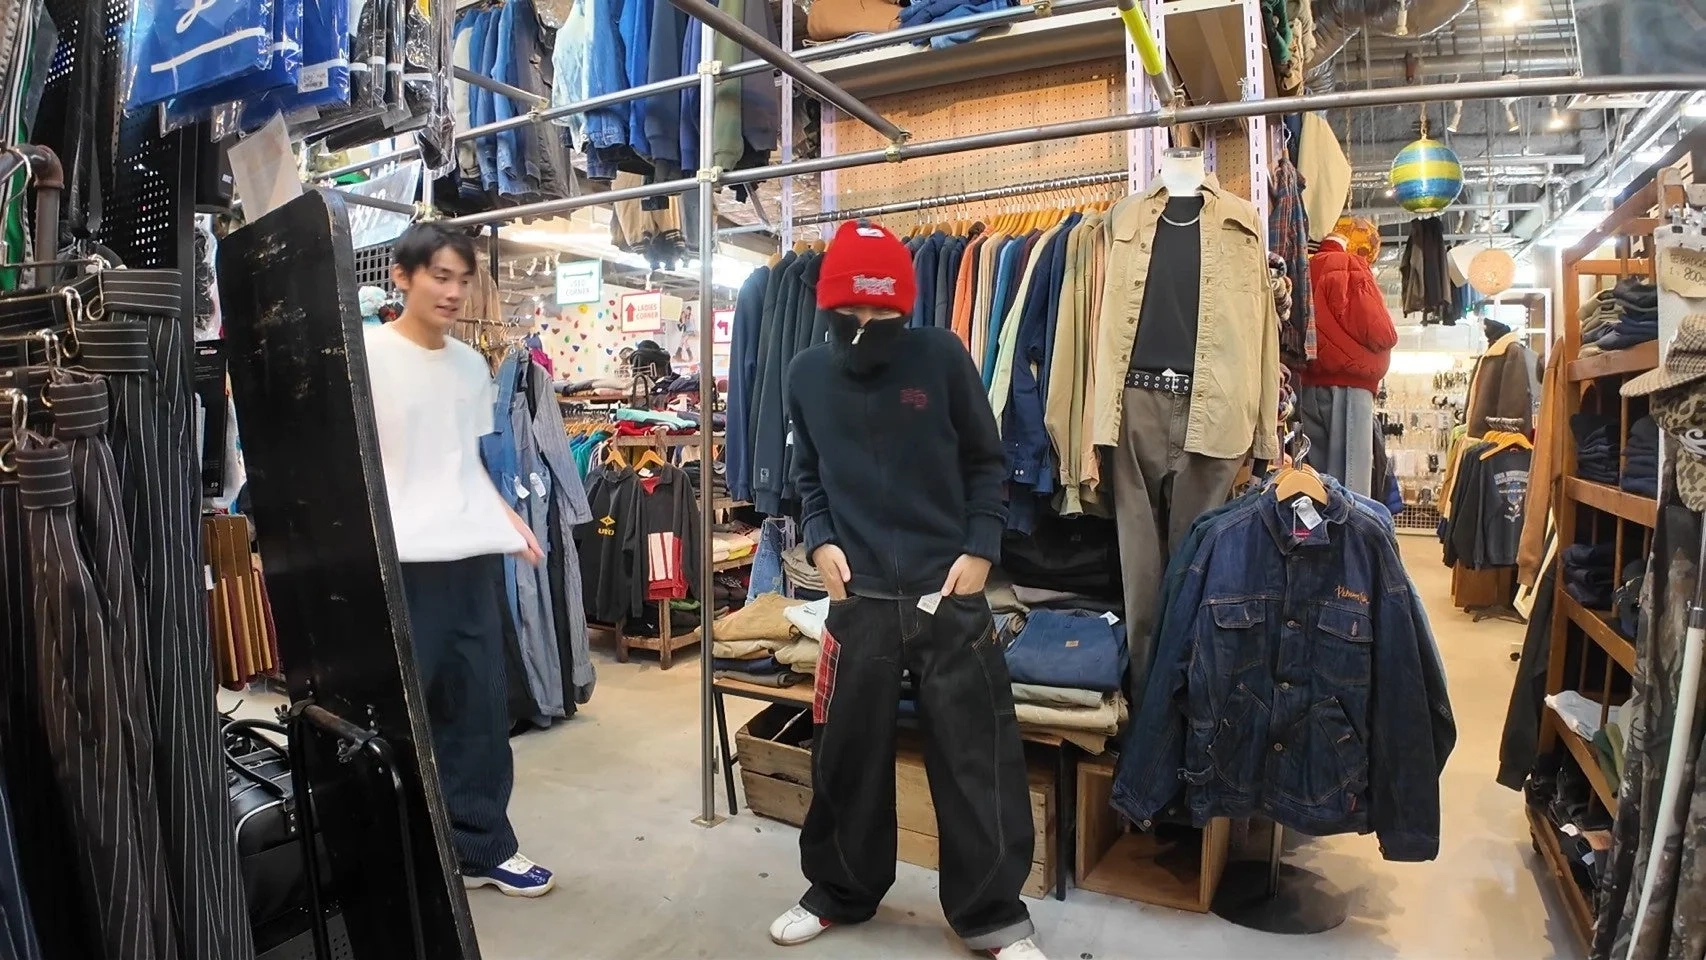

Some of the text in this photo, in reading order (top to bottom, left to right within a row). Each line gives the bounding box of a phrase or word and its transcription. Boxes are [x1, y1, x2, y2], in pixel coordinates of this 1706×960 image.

[565, 287, 590, 297] CORNER
[637, 303, 657, 312] LADIES
[635, 312, 658, 320] CORNER
